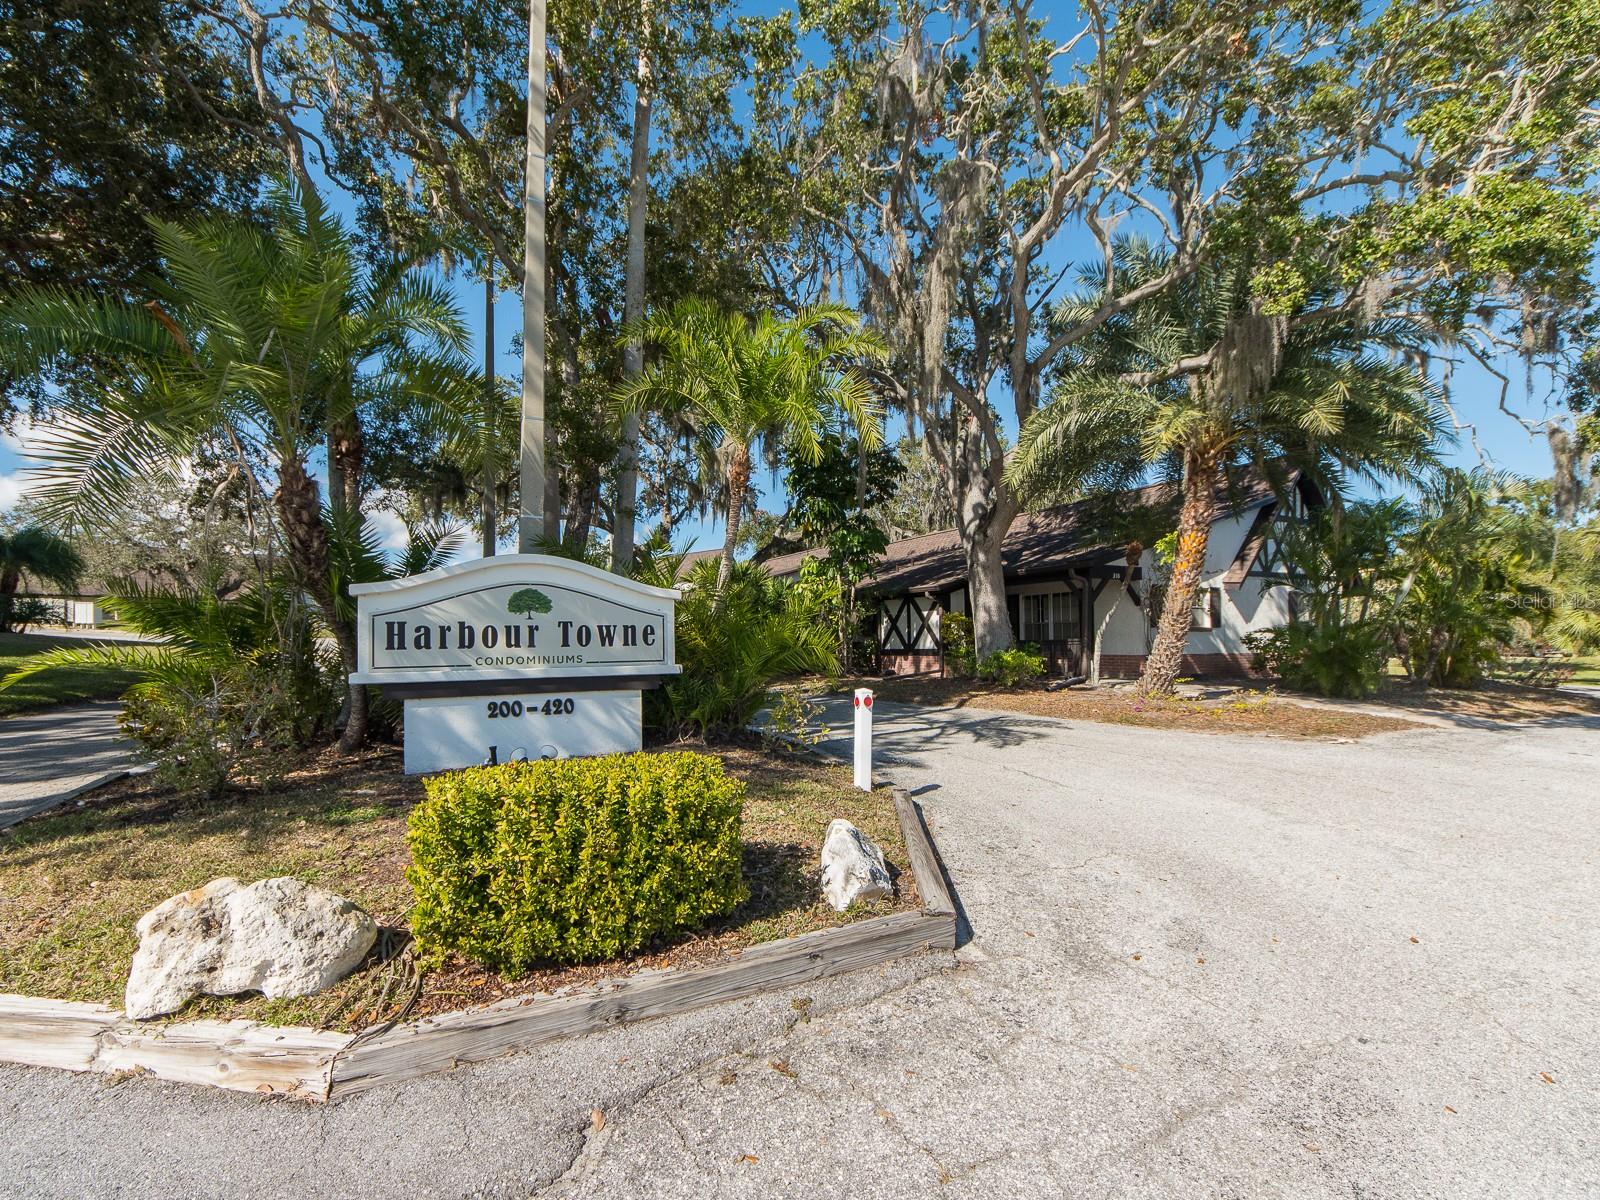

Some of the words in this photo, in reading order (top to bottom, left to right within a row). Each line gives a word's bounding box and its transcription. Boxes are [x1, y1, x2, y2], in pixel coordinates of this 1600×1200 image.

[385, 621, 540, 651] Harbour
[558, 620, 656, 648] Towne
[475, 654, 583, 666] CONDOMINIUMS
